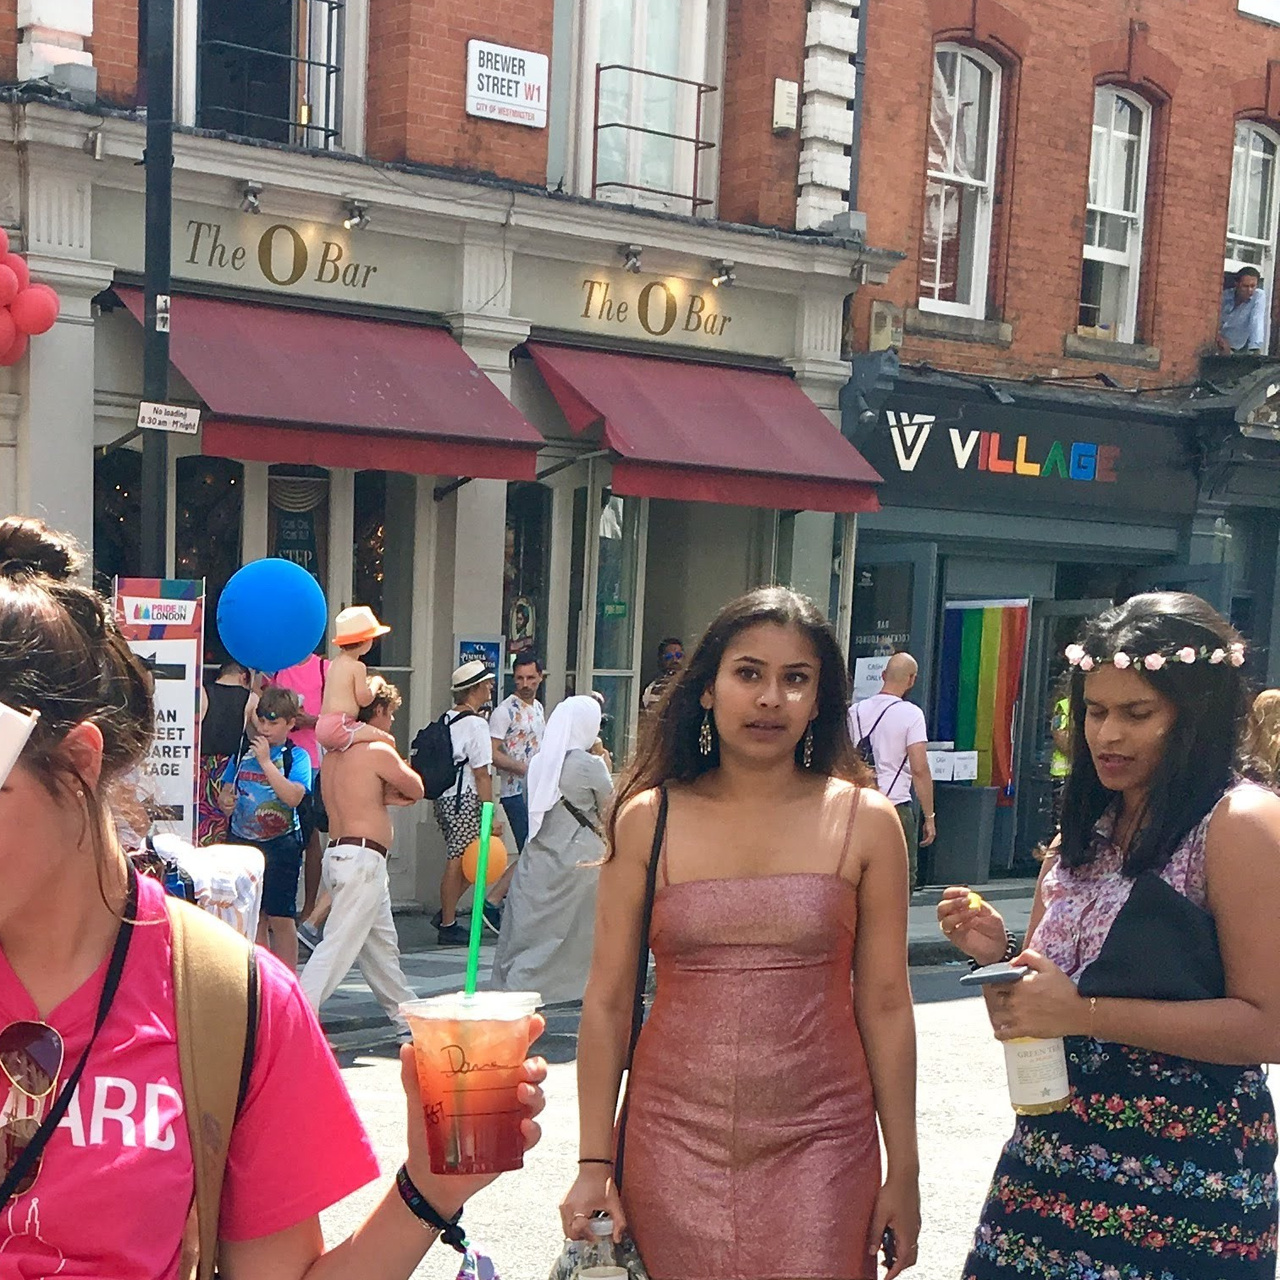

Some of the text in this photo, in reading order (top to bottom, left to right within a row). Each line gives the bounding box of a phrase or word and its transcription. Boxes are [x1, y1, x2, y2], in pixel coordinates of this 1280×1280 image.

[478, 50, 525, 76] BREWER
[477, 73, 541, 102] STREET W1
[476, 102, 535, 121] CITY OF WESTMINSTER
[185, 220, 378, 288] The O Bar
[580, 279, 732, 336] The O Bar
[153, 407, 188, 420] No loading
[140, 415, 196, 430] 8.30 am M'night
[949, 428, 1120, 483] VILLAGE
[151, 604, 187, 613] PRIDE IN
[151, 611, 187, 621] LONDON
[155, 709, 177, 723] AN
[154, 727, 186, 741] EET
[149, 745, 192, 759] ARET
[1017, 1048, 1047, 1058] GREEN
